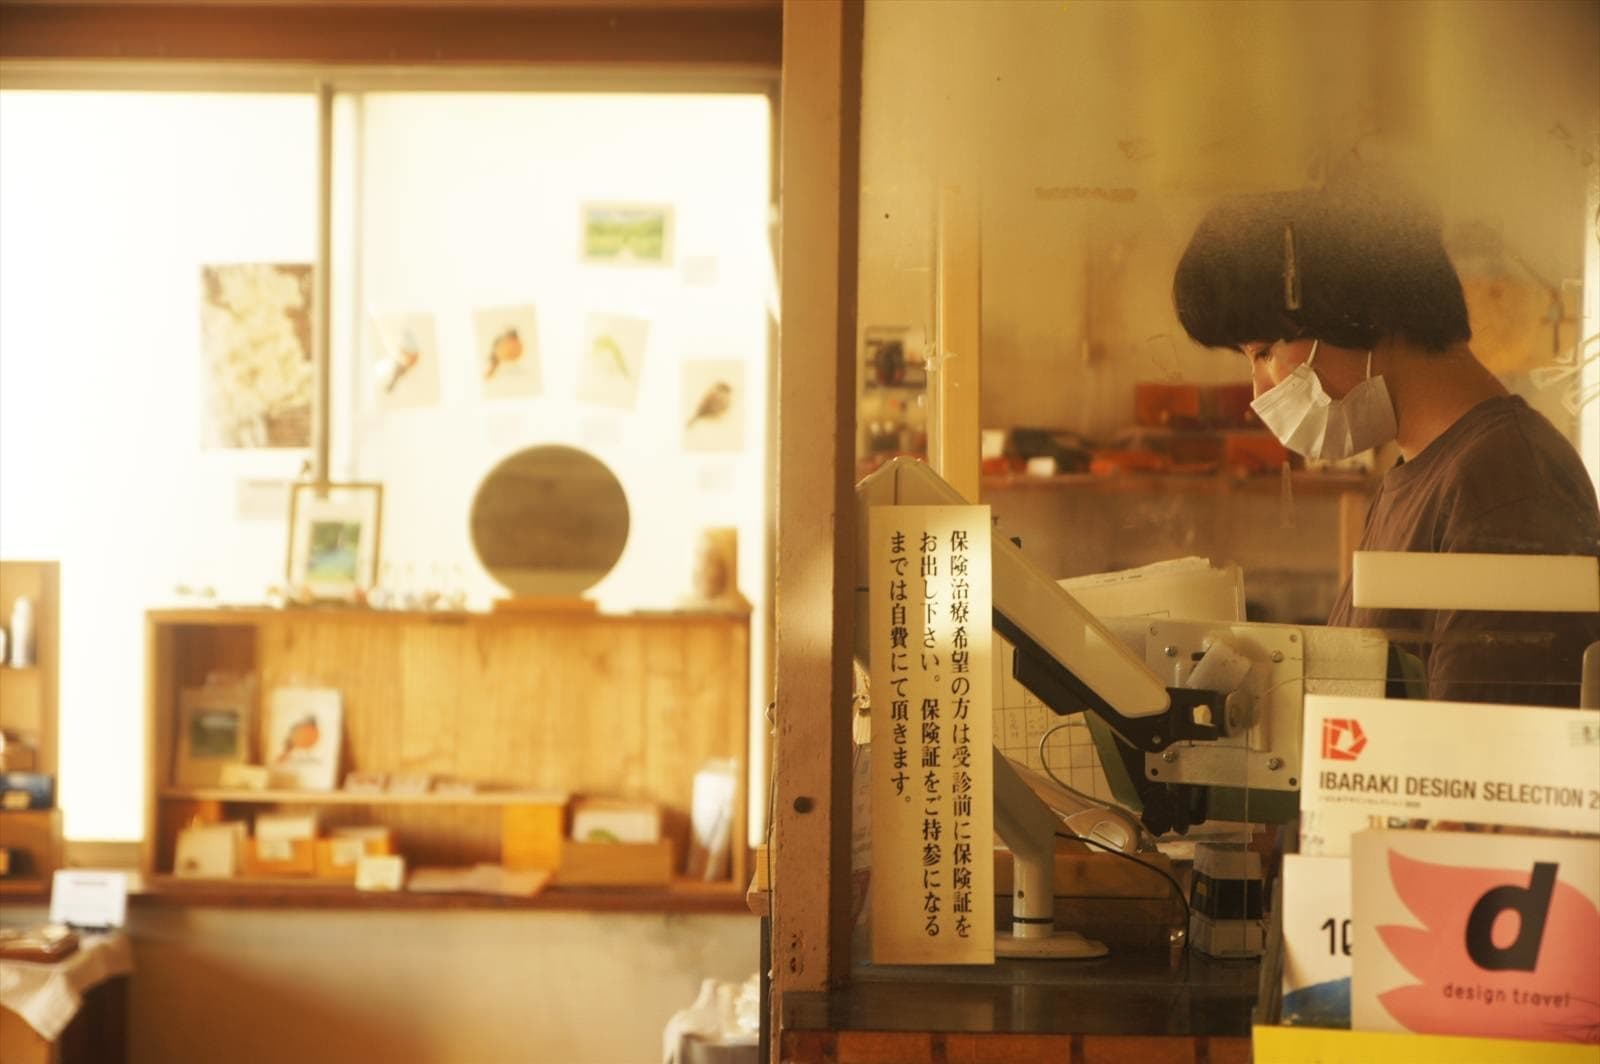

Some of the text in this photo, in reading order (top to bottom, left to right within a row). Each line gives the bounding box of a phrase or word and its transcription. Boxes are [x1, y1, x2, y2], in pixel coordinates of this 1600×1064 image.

[890, 531, 911, 803] までは自費にて頂きます。
[950, 530, 973, 938] 保険治療希望の方は受診前に保険証を
[1319, 771, 1399, 794] IBARAKI
[1405, 776, 1477, 799] DESIGN
[1482, 781, 1583, 809] SELECTION
[1465, 861, 1560, 973] d
[1443, 982, 1570, 1008] design travel
